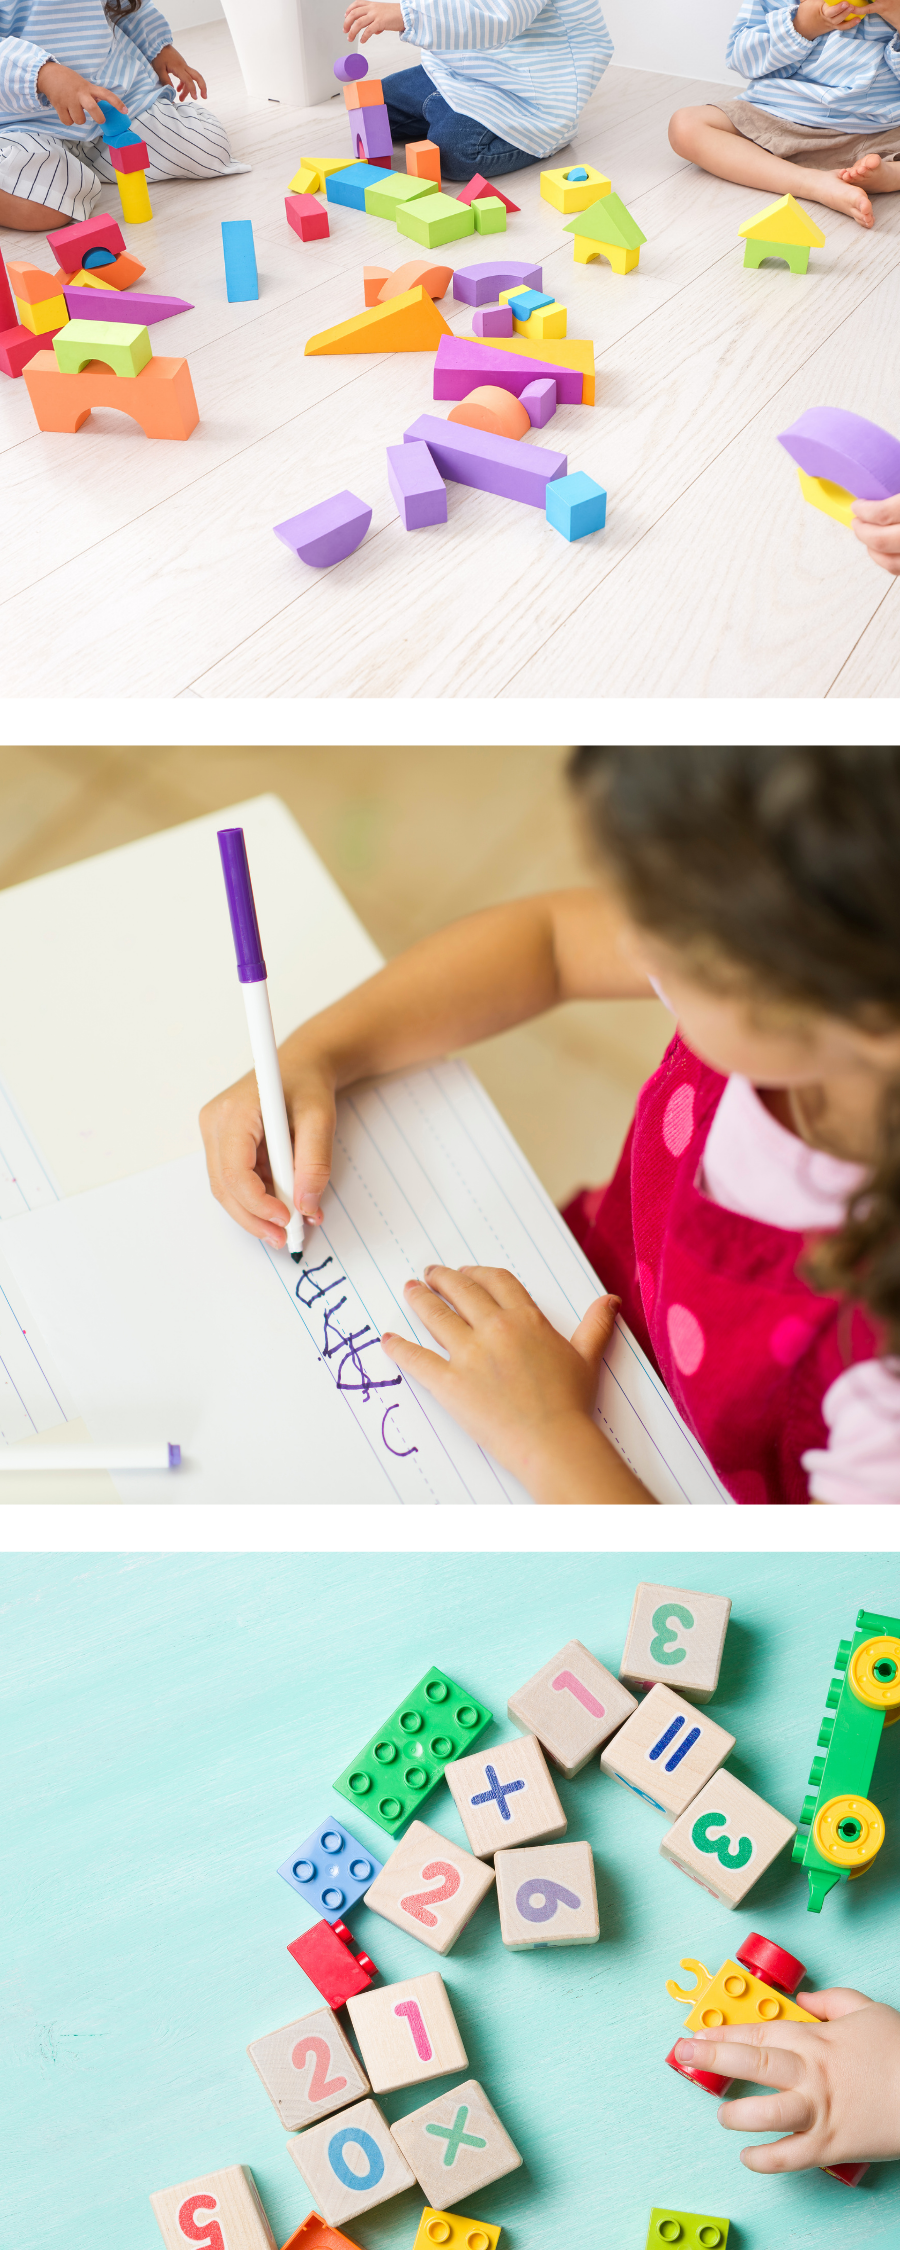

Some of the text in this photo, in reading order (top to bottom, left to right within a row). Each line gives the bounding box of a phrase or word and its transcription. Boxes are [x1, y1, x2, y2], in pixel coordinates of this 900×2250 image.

[649, 1603, 695, 1666] 3
[552, 1670, 605, 1719] 1
[691, 1811, 753, 1870] 3
[400, 1861, 461, 1928] 2
[394, 2000, 433, 2062] 1
[291, 2036, 348, 2103] 2
[178, 2194, 226, 2250] 5
